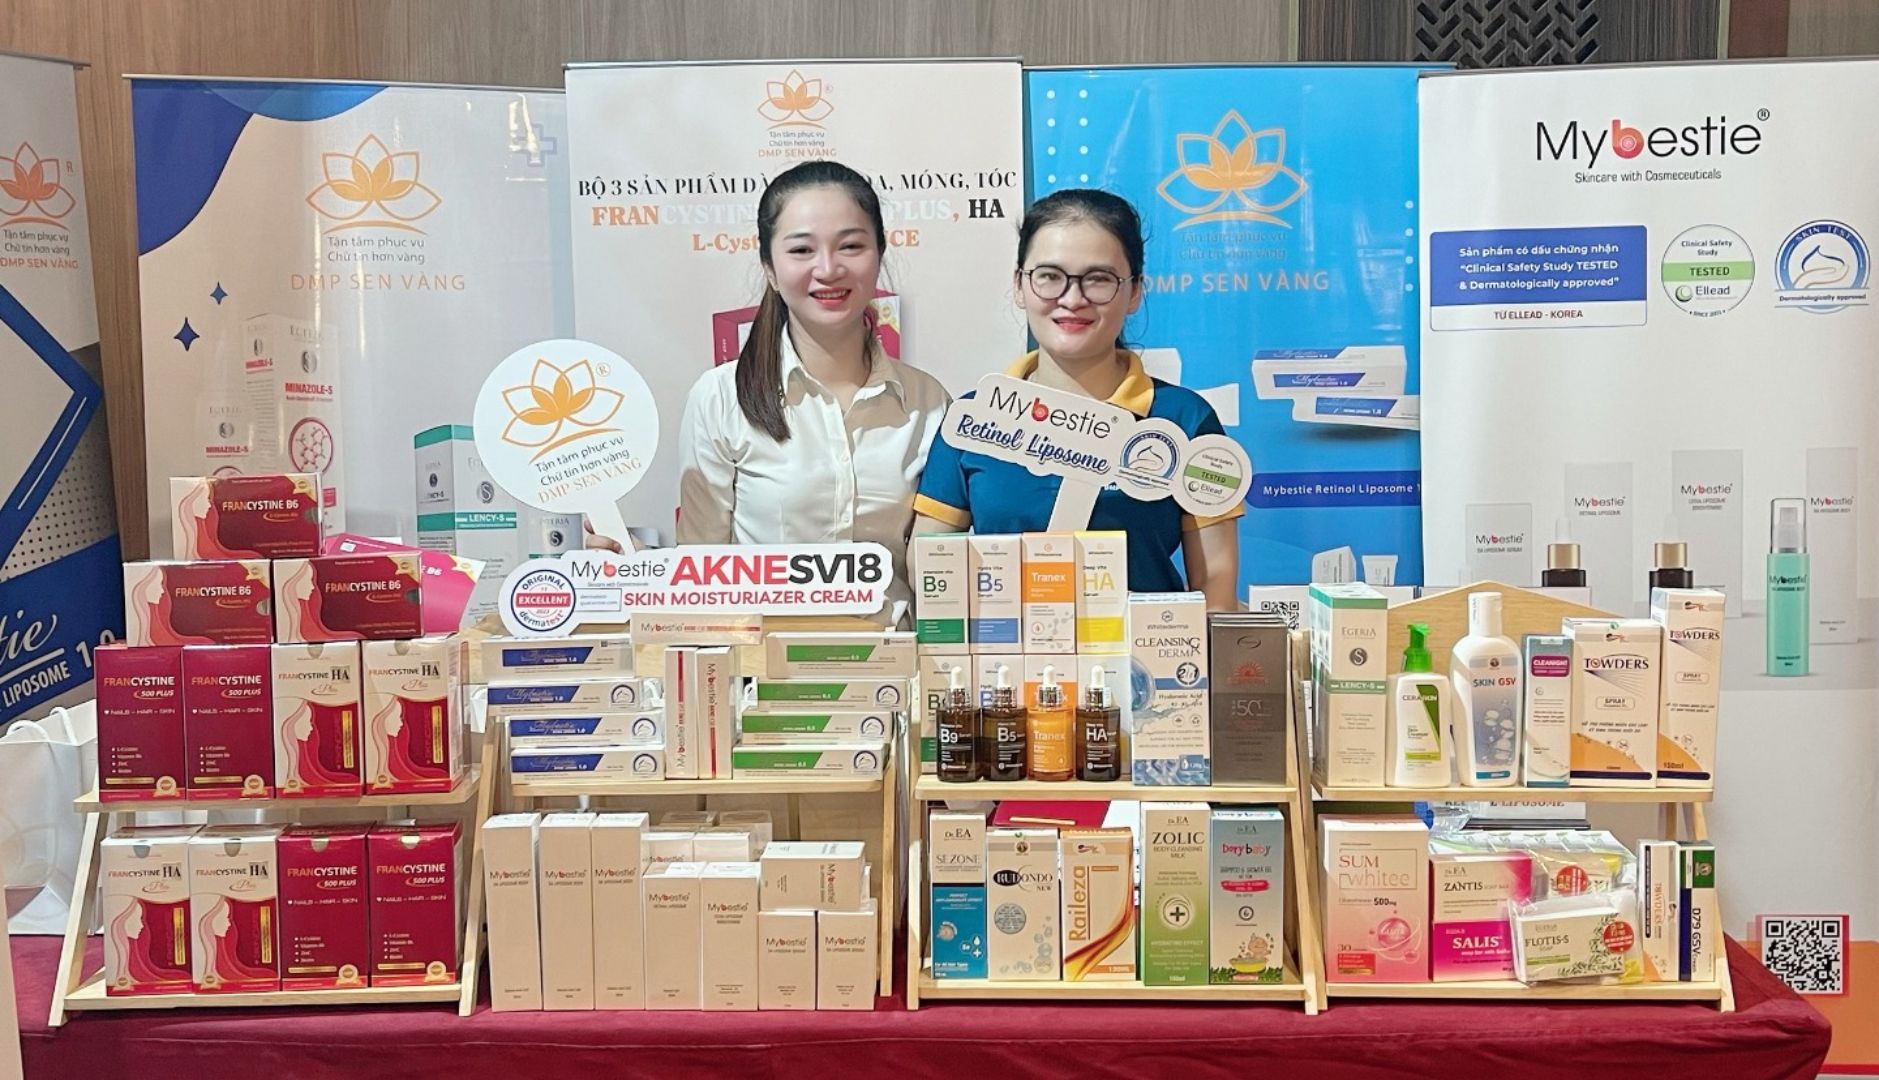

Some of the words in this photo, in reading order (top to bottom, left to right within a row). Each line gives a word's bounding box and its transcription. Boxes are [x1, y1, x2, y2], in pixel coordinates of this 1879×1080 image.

[1536, 115, 1761, 169] Mybestie
[785, 149, 805, 157] SEN
[1575, 171, 1617, 183] Skincare
[1620, 170, 1642, 182] with
[1645, 168, 1721, 181] Cosmeceuticals
[579, 176, 606, 199] BỘ
[611, 180, 622, 196] 3
[627, 174, 668, 196] SẢN
[676, 172, 735, 194] PHẨM
[901, 169, 969, 190] MÓNG,
[974, 168, 1016, 188] TÓC
[969, 199, 1005, 218] HA
[1795, 226, 1820, 241] SKIN
[1827, 226, 1850, 240] TEST
[1681, 240, 1707, 248] Clinical
[1709, 240, 1732, 249] Safety
[1459, 247, 1479, 257] Sản
[1482, 245, 1513, 258] phẩm
[1516, 246, 1528, 255] có
[1531, 245, 1550, 255] dấu
[1591, 244, 1618, 254] nhận
[1698, 248, 1718, 257] Study
[0, 258, 24, 267] DMP
[25, 258, 48, 268] SEN
[1508, 262, 1540, 274] Safety
[1543, 261, 1573, 273] Study
[1576, 261, 1618, 270] TESTED
[1689, 266, 1730, 276] TESTED
[292, 273, 340, 290] DMP
[351, 273, 392, 290] SEN
[402, 271, 465, 290] VÀNG
[1202, 272, 1248, 292] SEN
[1258, 269, 1329, 291] VÀNG
[1459, 281, 1467, 290] &
[1470, 279, 1559, 291] Dermatologically
[1695, 286, 1730, 296] Ellead
[1509, 310, 1542, 319] ELLEAD
[1551, 310, 1583, 319] KOREA
[989, 386, 1111, 440] Mybestie
[957, 414, 1022, 450] Retinol
[1025, 434, 1111, 475] Liposome
[536, 460, 556, 473] Tận
[557, 454, 579, 466] tâm
[581, 443, 608, 458] phục
[611, 436, 624, 448] vụ
[541, 473, 563, 487] Chữ
[564, 466, 579, 479] tín
[580, 459, 602, 472] hơn
[604, 449, 630, 465] vàng
[538, 483, 570, 503] DMP
[574, 470, 603, 491] SEN
[604, 457, 642, 483] VÀNG
[1201, 471, 1226, 483] TESTED
[1263, 486, 1313, 496] Mybestie
[1316, 485, 1355, 493] Retinol
[1359, 485, 1413, 494] Liposome
[1681, 484, 1731, 496] Mybestie
[222, 500, 284, 512] FRANCYSTINE
[286, 499, 299, 510] B6
[1575, 497, 1624, 508] Mybestie
[1811, 497, 1853, 506] Mybestie
[1475, 535, 1523, 545] Mybestie
[427, 566, 442, 576] B6
[571, 560, 666, 581] Mybestie
[669, 553, 883, 586] AKNESV18
[522, 574, 566, 590] ORIGINAL
[977, 572, 1003, 592] B5
[1031, 572, 1065, 582] Tranex
[1083, 572, 1115, 591] HA
[325, 581, 386, 593] FRANCYSTINE
[389, 580, 401, 591] B6
[924, 575, 948, 593] B9
[175, 586, 236, 598] FRANCYSTINE
[239, 586, 252, 596] B6
[624, 592, 665, 607] SKIN
[670, 590, 807, 606] MOISTURIAZER
[810, 589, 873, 604] CREAM
[518, 596, 568, 604] EXCELLENT
[519, 610, 564, 627] dermatest
[1341, 627, 1376, 637] EGERIA
[1670, 630, 1720, 640] TOWDERS
[1135, 637, 1200, 650] CLEANSING
[1584, 657, 1649, 669] TOWDERS
[279, 672, 329, 681] FRANCYSTINE
[331, 669, 349, 681] HA
[422, 665, 439, 676] HA
[2, 660, 71, 708] LIPOSOME
[104, 677, 175, 687] FRANCYSTINE
[192, 675, 262, 685] FRANCYSTINE
[1473, 678, 1495, 687] SKIN
[1498, 677, 1516, 686] GSV
[244, 688, 261, 696] PLUS
[940, 728, 959, 743] B9
[998, 727, 1016, 742] B5
[1034, 731, 1065, 741] Tranex
[1086, 728, 1107, 741] HA
[1152, 832, 1205, 845] ZOLIC
[1339, 855, 1379, 868] SUM
[108, 869, 160, 878] FRANCYSTINE
[163, 866, 181, 878] HA
[196, 868, 247, 876] FRANCYSTINE
[250, 864, 268, 876] HA
[288, 866, 357, 877] FRANCYSTINE
[376, 863, 446, 874] FRANCYSTINE
[1349, 869, 1409, 887] whitee
[1444, 881, 1483, 891] ZANTIS
[1068, 865, 1086, 941] Raileza
[1691, 908, 1701, 930] D79
[1452, 937, 1500, 949] SALIS
